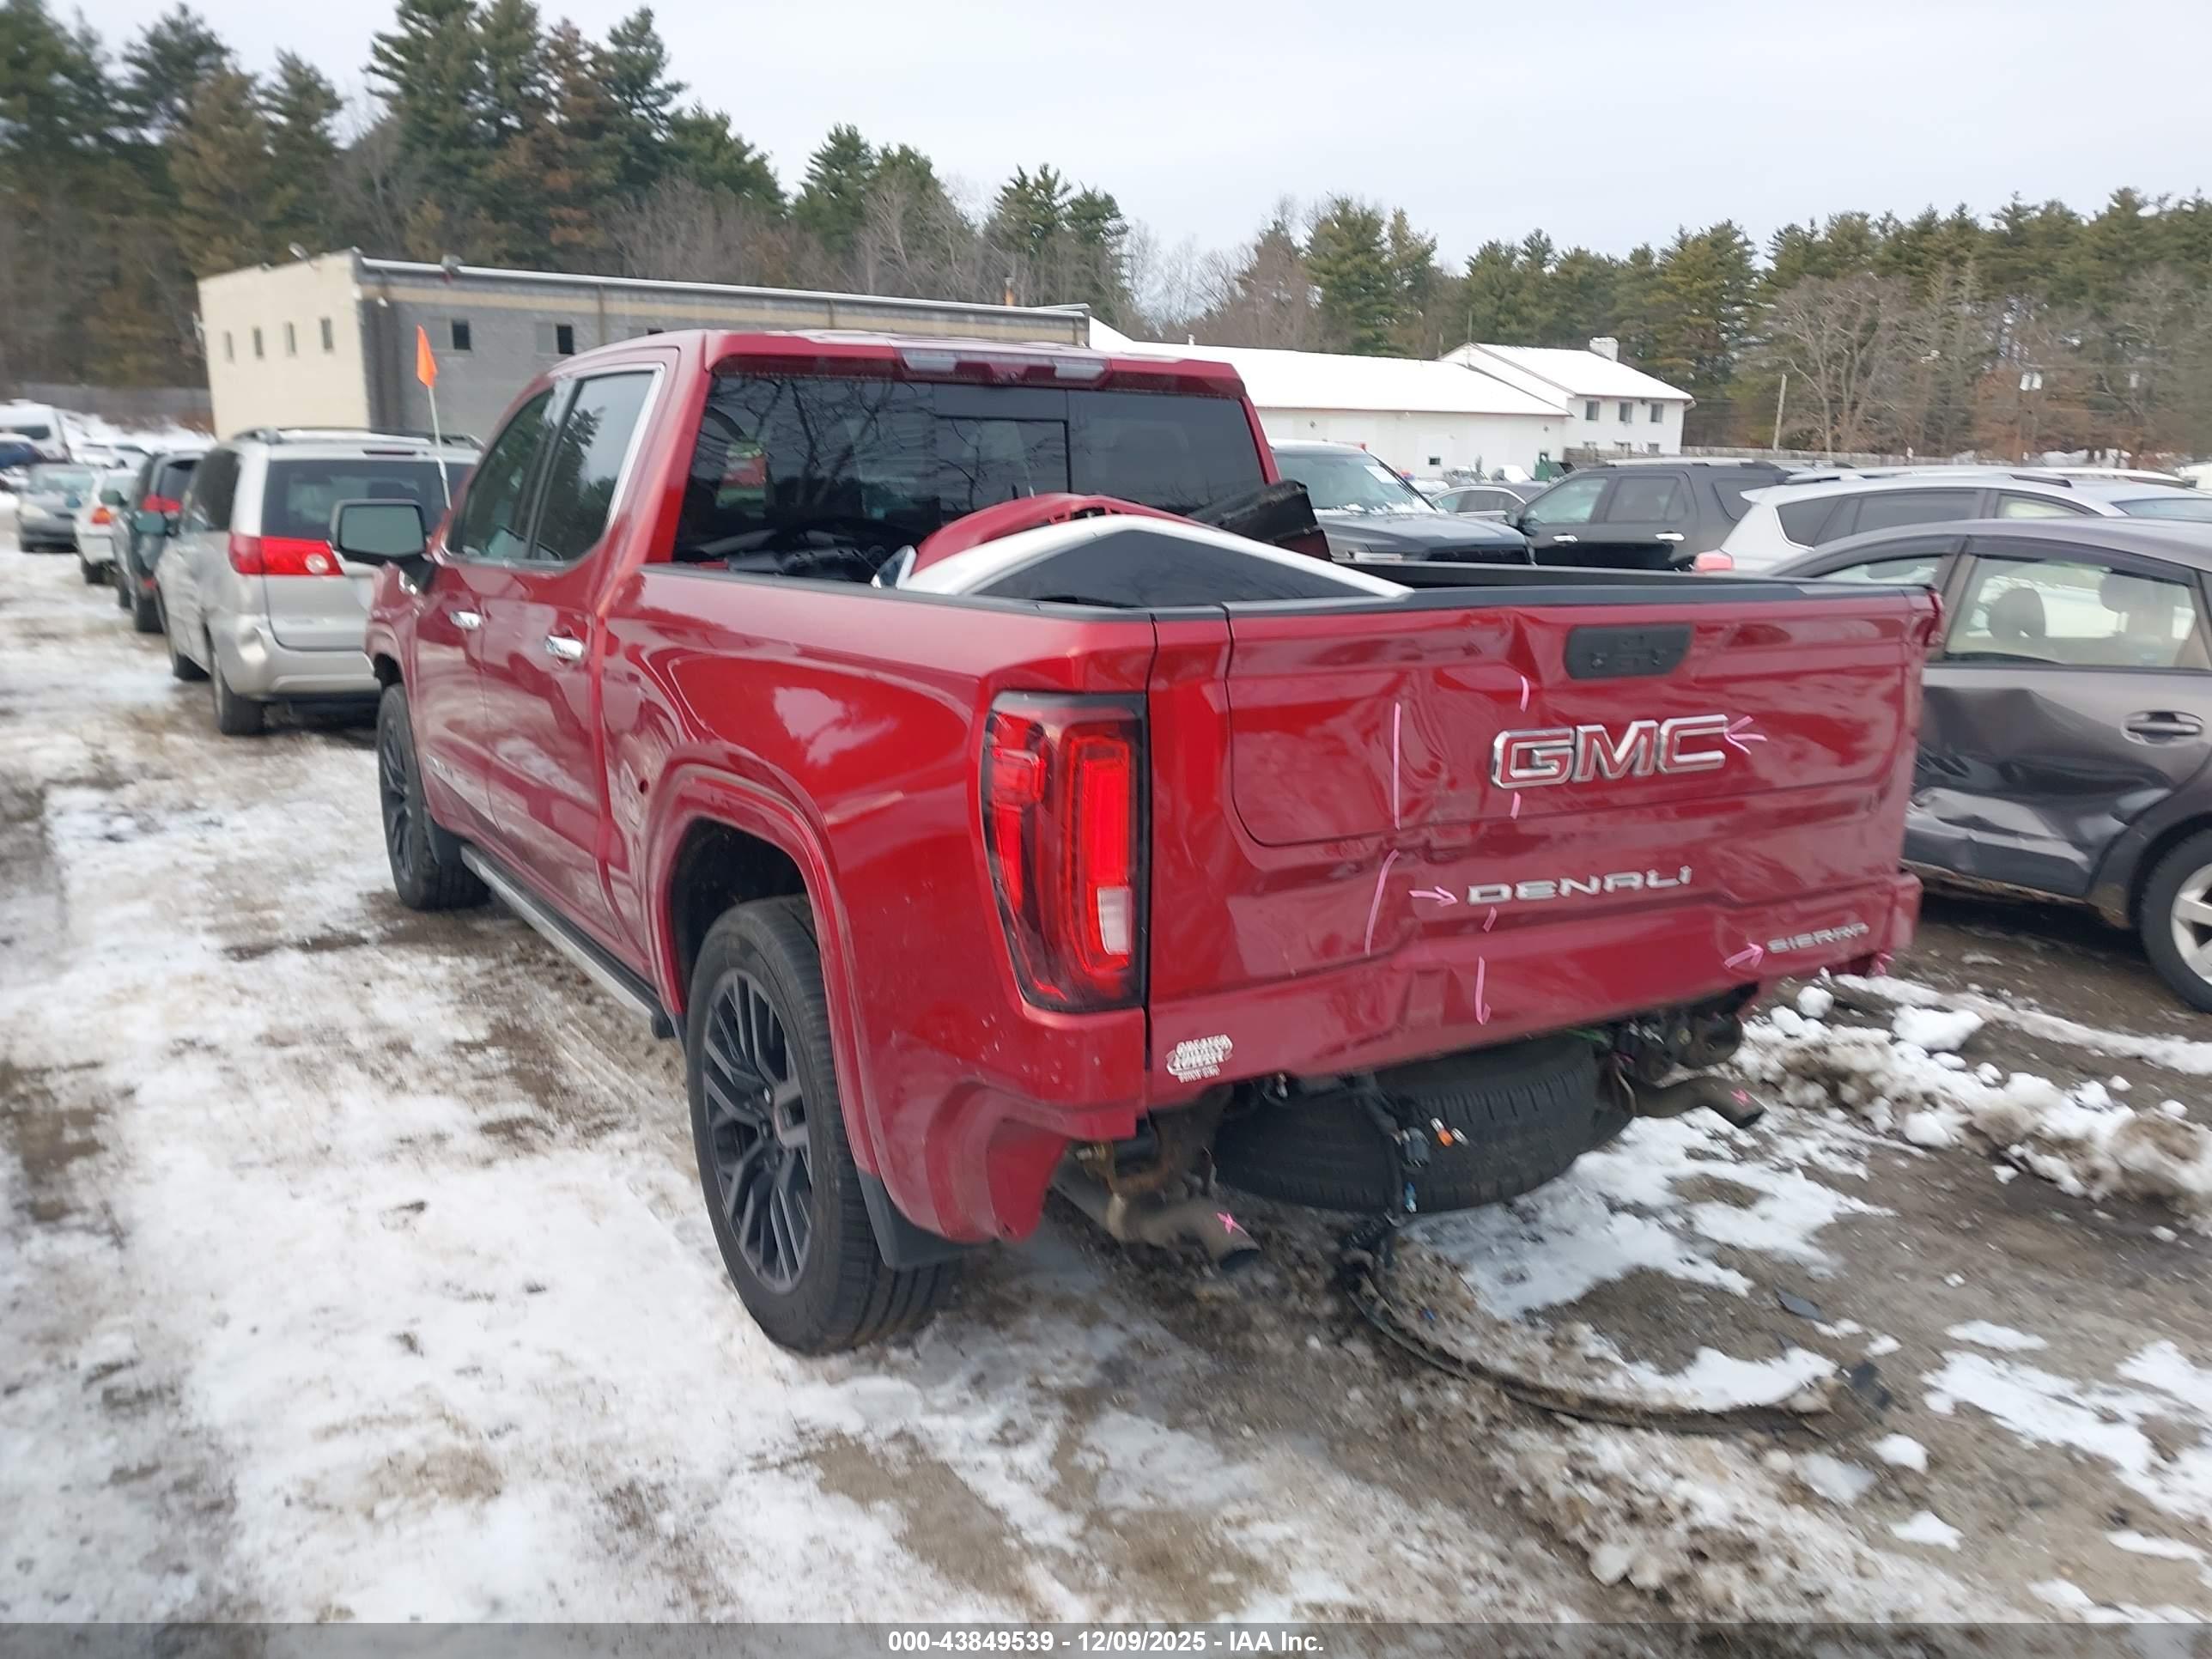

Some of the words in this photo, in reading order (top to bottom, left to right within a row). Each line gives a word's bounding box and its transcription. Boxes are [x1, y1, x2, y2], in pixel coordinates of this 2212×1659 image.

[1491, 714, 1729, 789] GMC
[1468, 865, 1692, 905] DENALI
[1766, 922, 1869, 954] SIERRA
